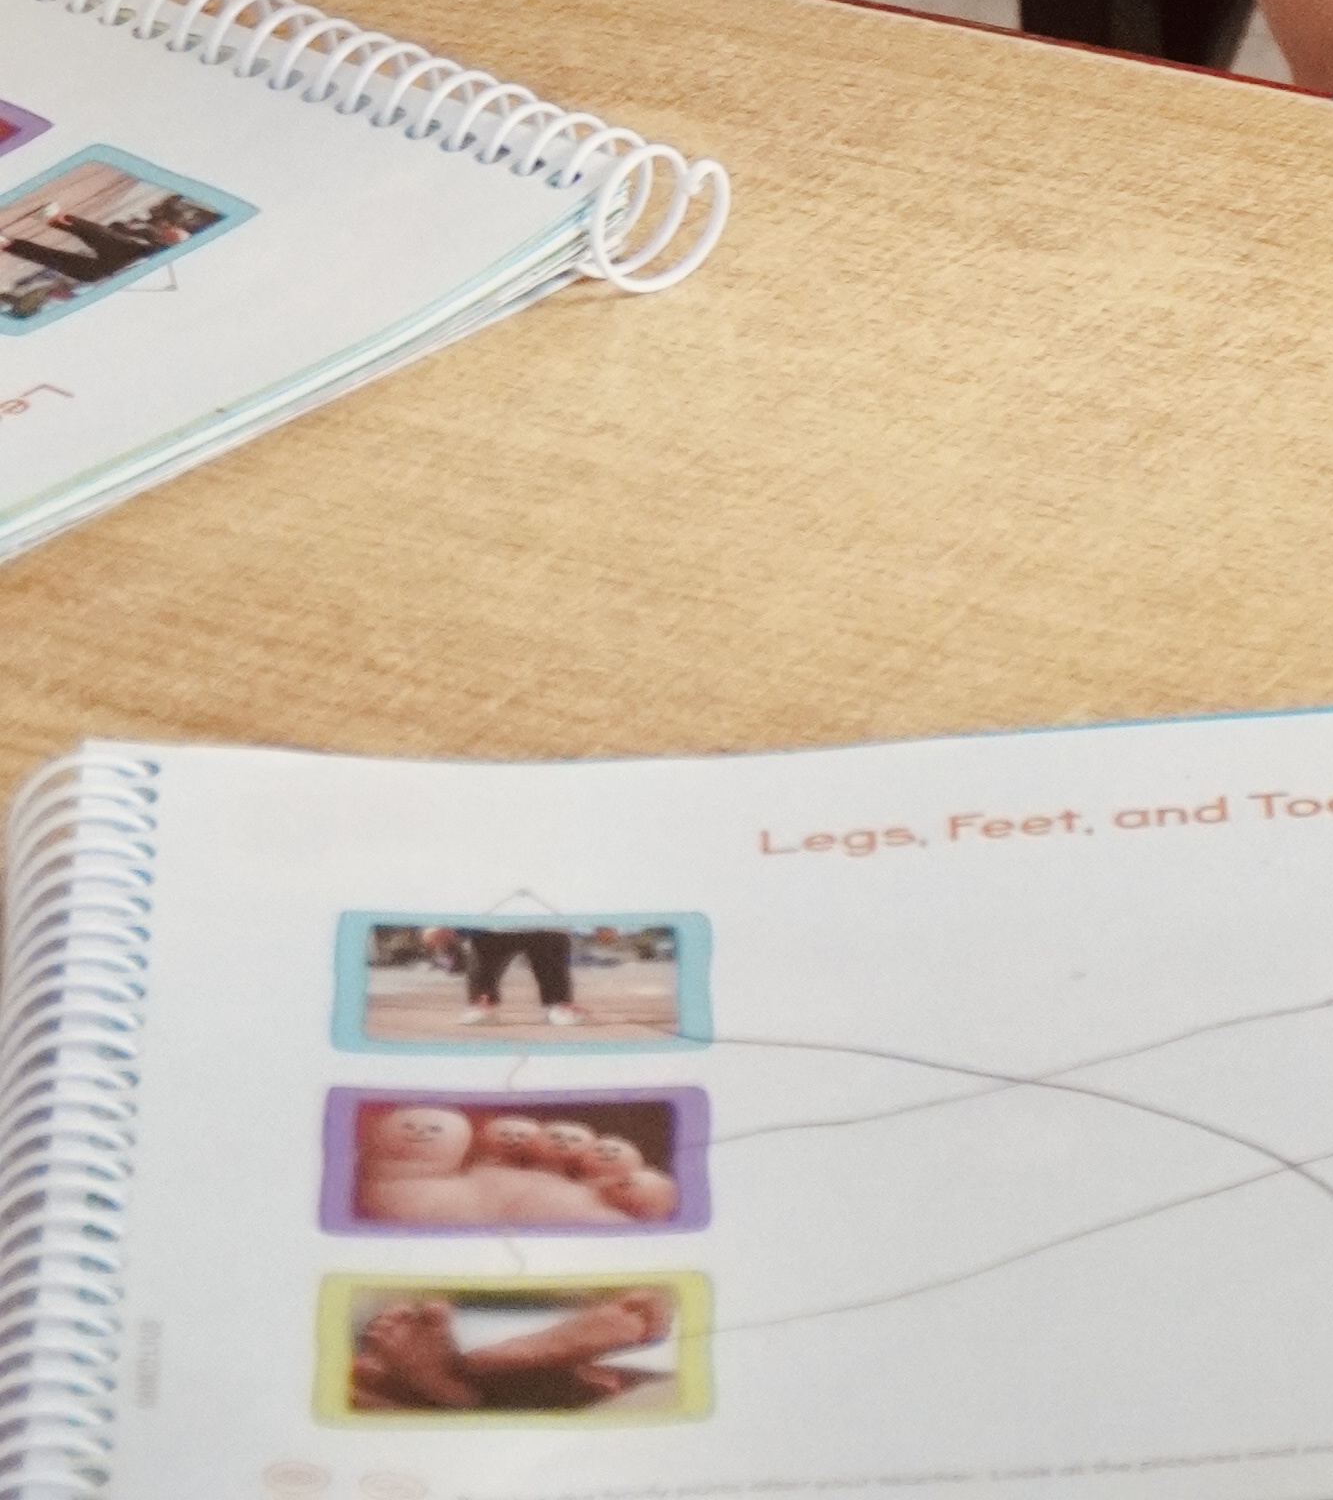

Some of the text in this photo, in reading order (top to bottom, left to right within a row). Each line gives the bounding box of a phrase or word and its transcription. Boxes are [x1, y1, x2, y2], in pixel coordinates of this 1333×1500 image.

[760, 826, 927, 857] Legs,
[946, 809, 1095, 842] Feet,
[1112, 796, 1229, 830] and
